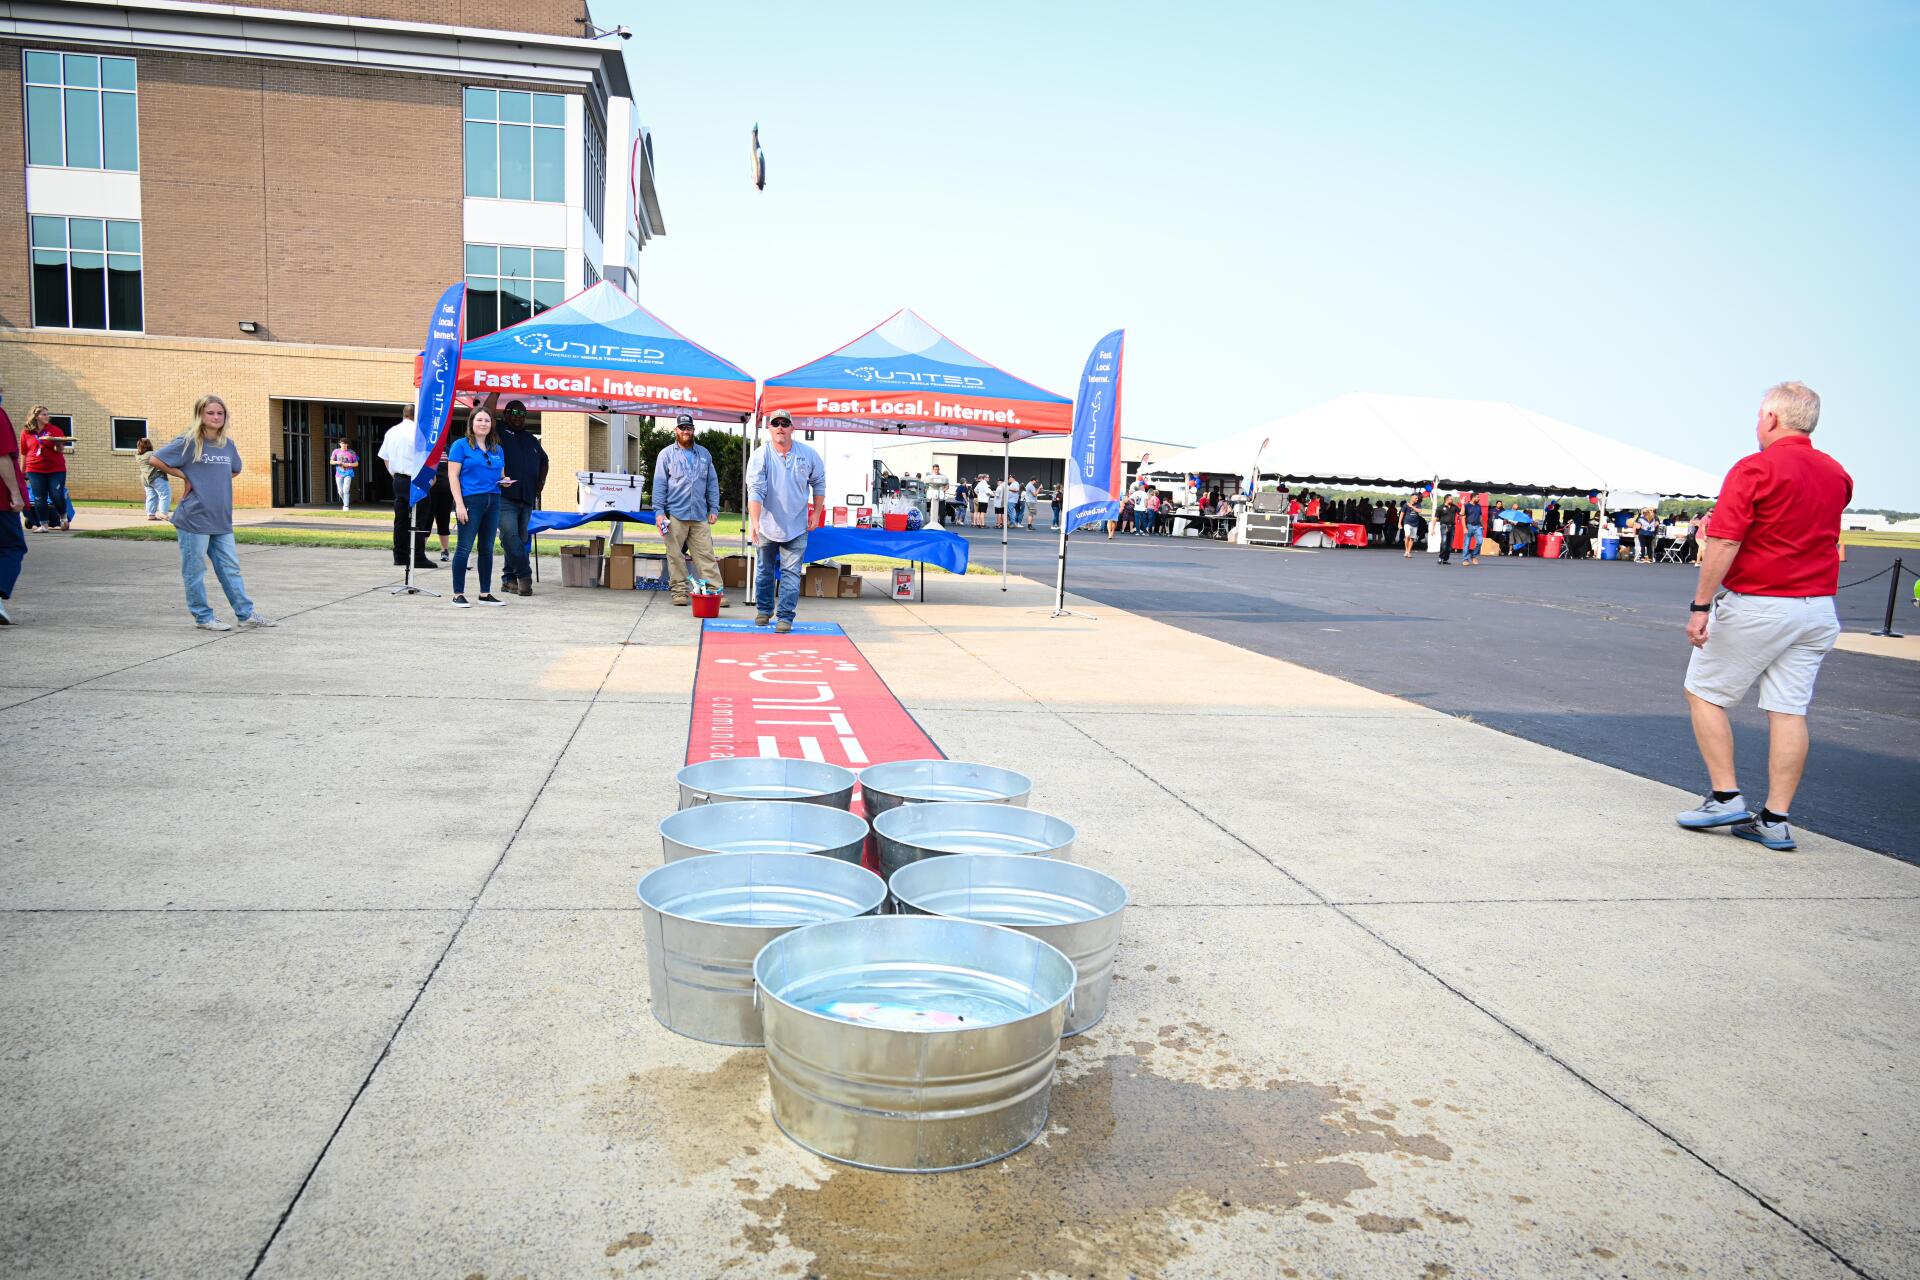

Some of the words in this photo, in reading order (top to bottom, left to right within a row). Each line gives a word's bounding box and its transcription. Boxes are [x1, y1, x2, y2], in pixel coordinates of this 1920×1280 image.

[546, 339, 665, 359] UNITED
[473, 370, 528, 389] Fast.
[533, 373, 598, 393] Local.
[603, 378, 698, 402] Internet.
[875, 370, 984, 386] UNITED
[430, 368, 445, 444] UNITED
[816, 398, 865, 413] Fast.
[871, 399, 929, 416] Local.
[934, 401, 1021, 424] Internet.
[748, 669, 870, 765] UNITE
